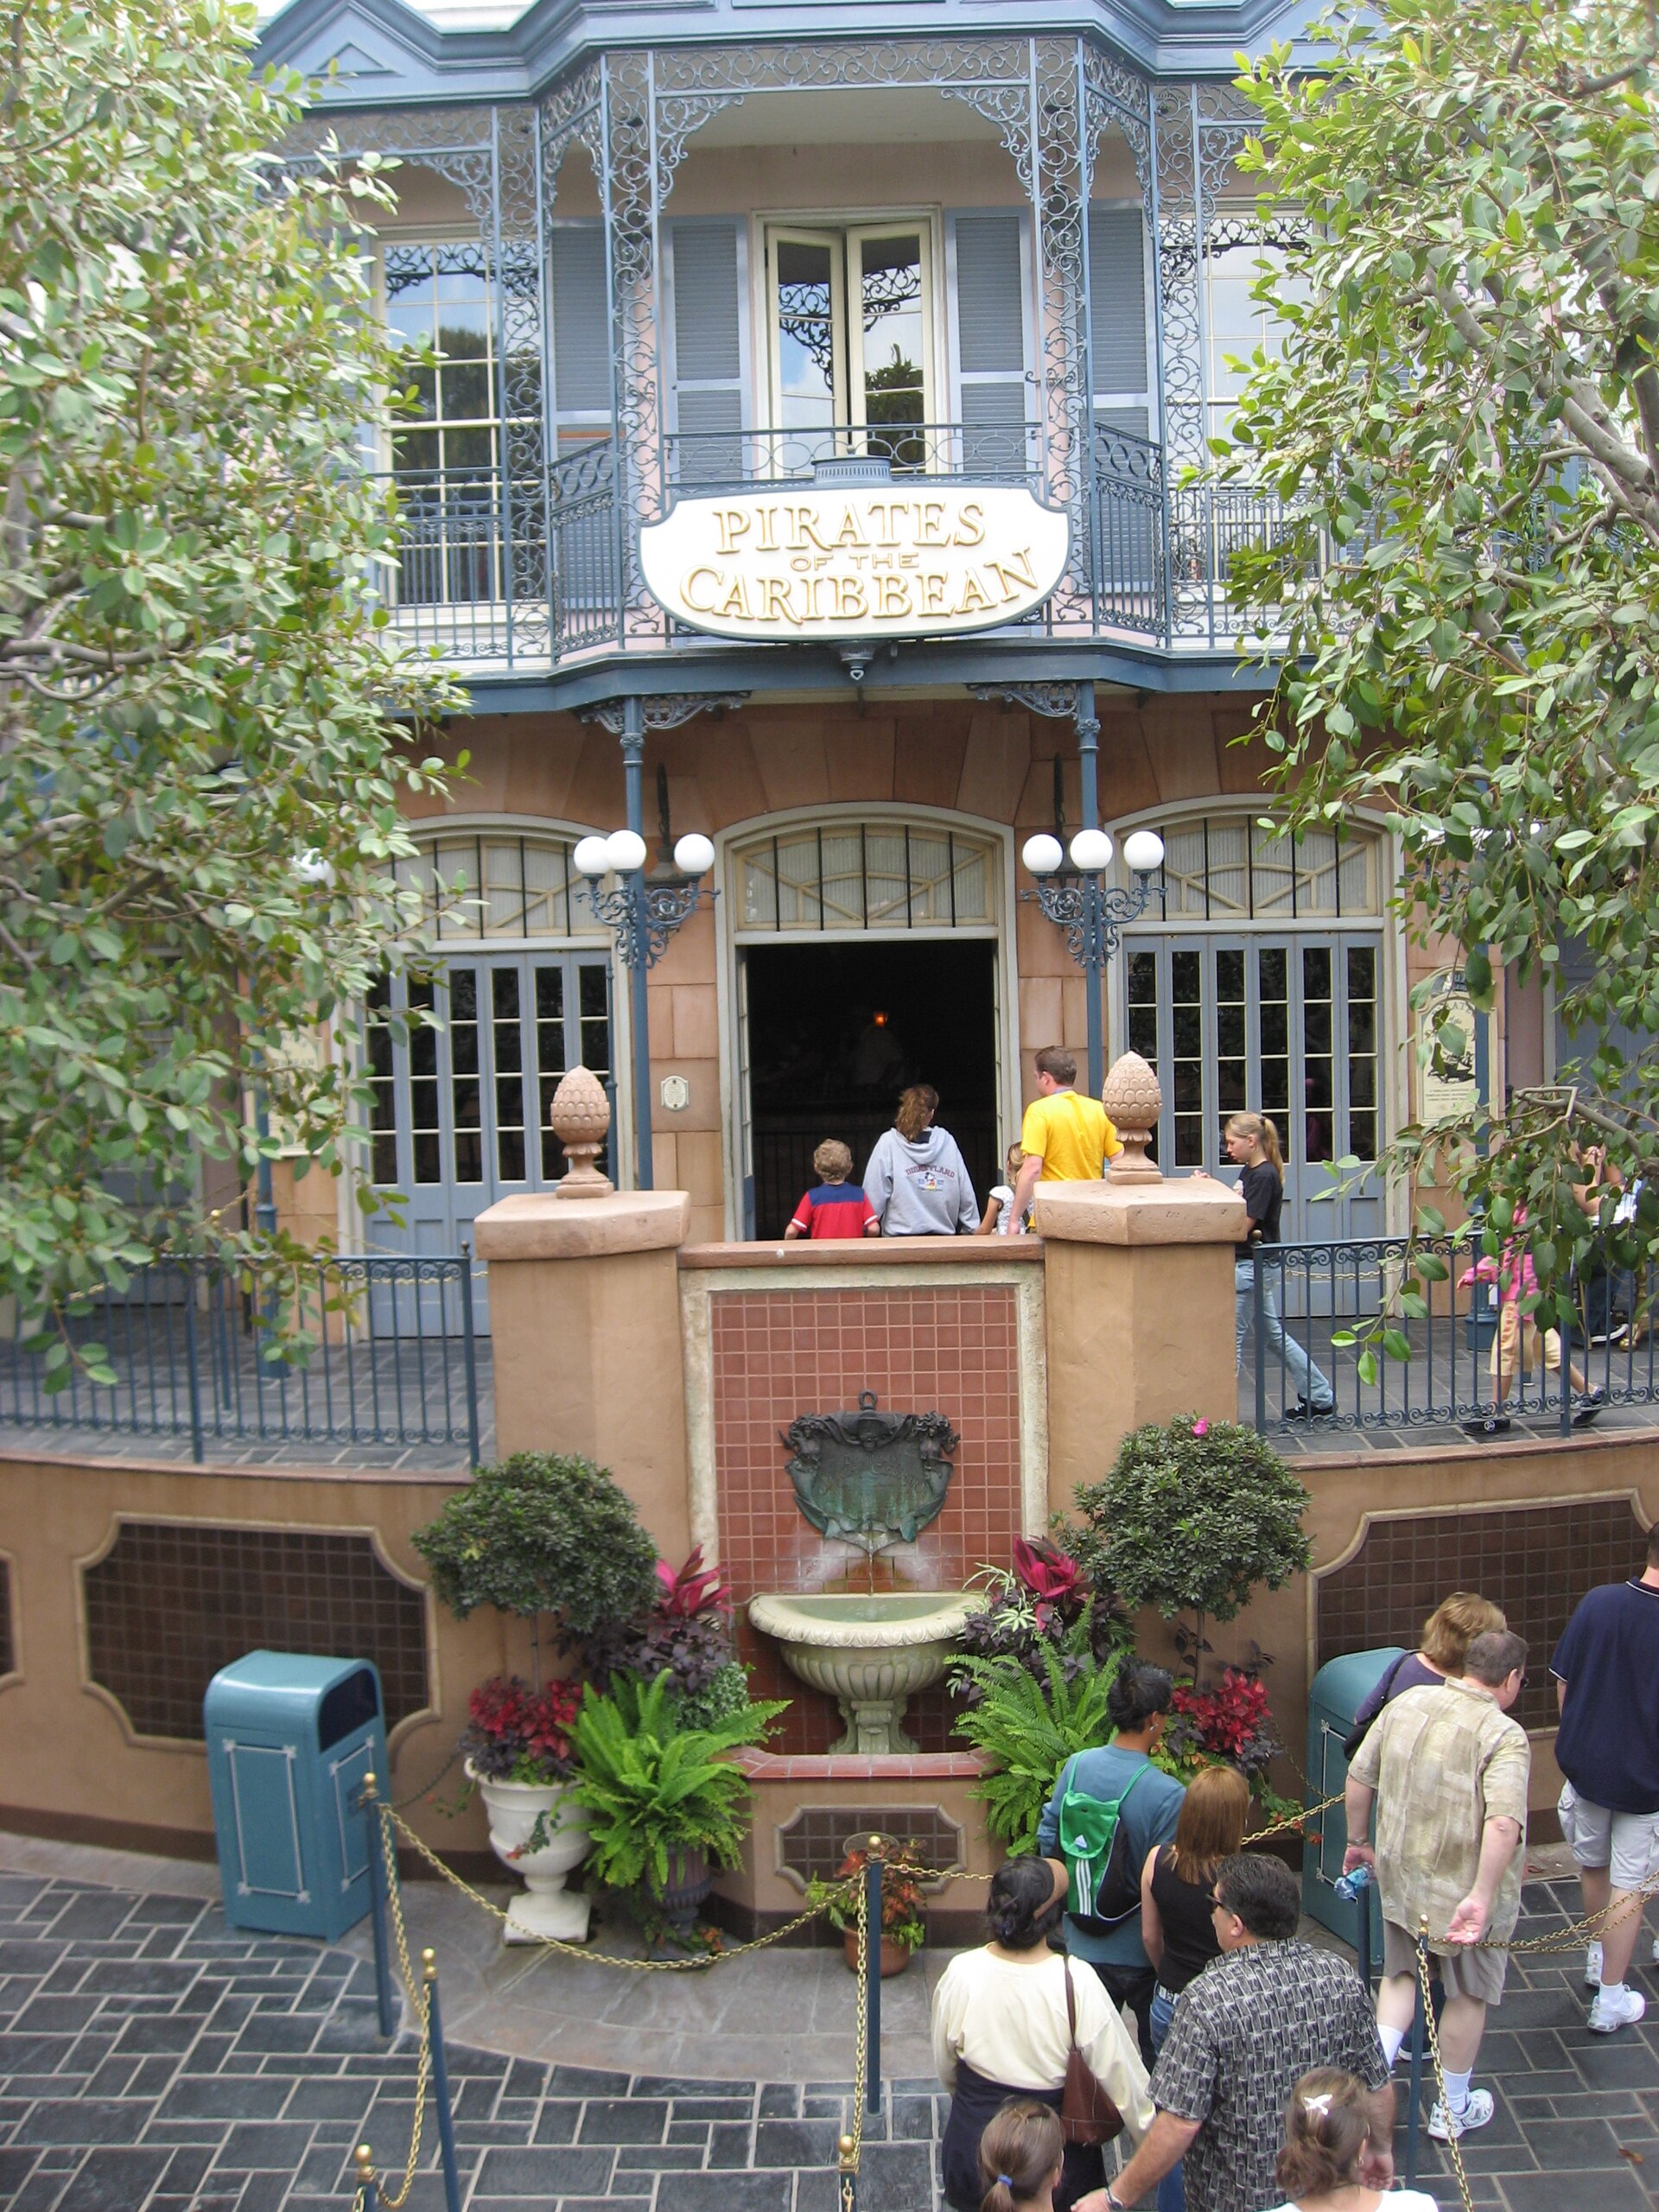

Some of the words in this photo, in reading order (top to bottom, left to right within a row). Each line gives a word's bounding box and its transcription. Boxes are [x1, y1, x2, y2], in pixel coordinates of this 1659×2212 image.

[714, 501, 985, 554] PIRATES
[679, 546, 1039, 624] CARIBBEAN
[790, 554, 834, 572] OF
[849, 552, 919, 569] THE
